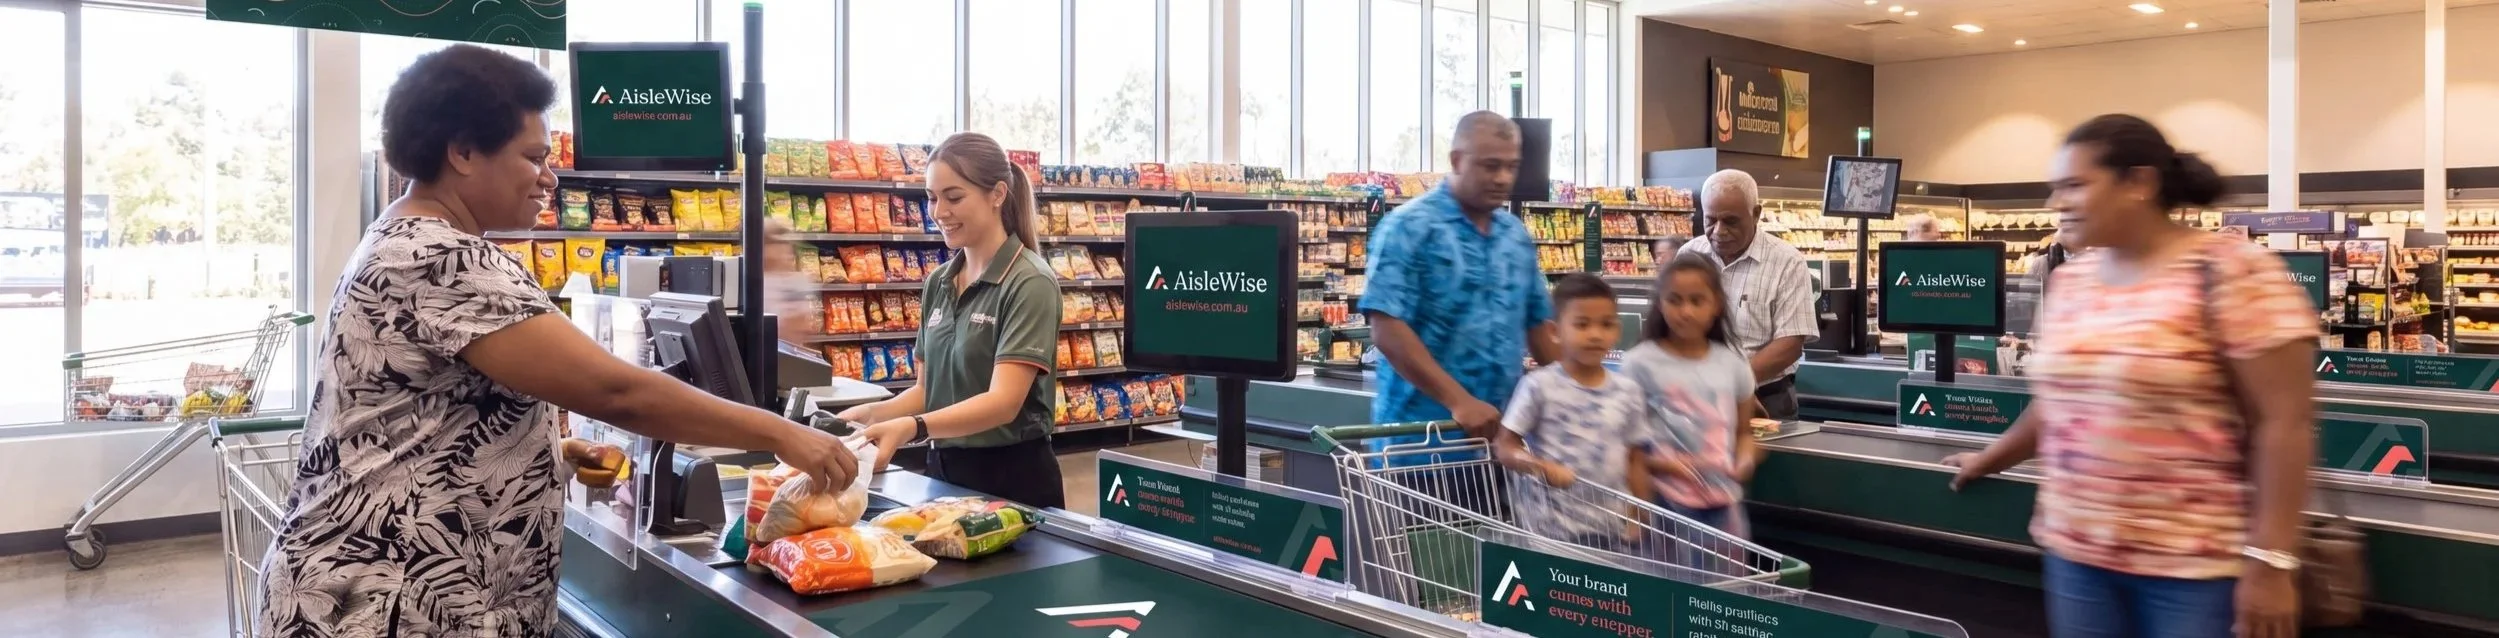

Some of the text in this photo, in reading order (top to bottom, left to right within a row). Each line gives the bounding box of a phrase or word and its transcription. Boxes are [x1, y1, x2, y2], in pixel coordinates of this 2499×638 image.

[619, 88, 711, 104] AisleWise
[1173, 270, 1268, 293] AisleWise
[1916, 274, 1986, 286] AisleWise
[1165, 300, 1248, 313] aislewise.com.au
[1549, 567, 1628, 597] Your brand
[1597, 598, 1632, 616] with
[1549, 606, 1588, 626] every
[1688, 614, 1712, 627] with
